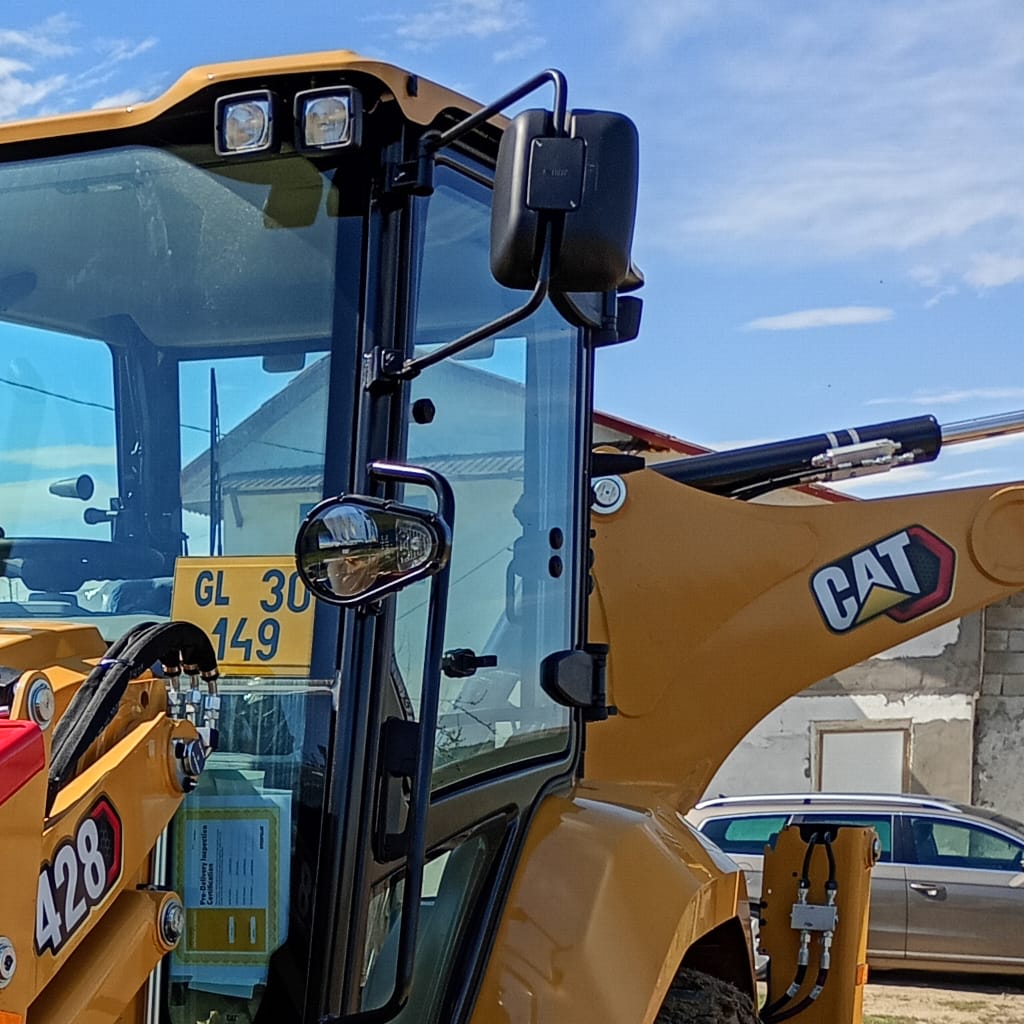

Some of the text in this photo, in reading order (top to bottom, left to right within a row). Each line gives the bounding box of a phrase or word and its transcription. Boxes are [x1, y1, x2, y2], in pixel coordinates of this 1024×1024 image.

[194, 568, 311, 613] GL 30
[812, 530, 921, 631] CAT
[211, 616, 281, 662] 149
[35, 818, 107, 950] 428
